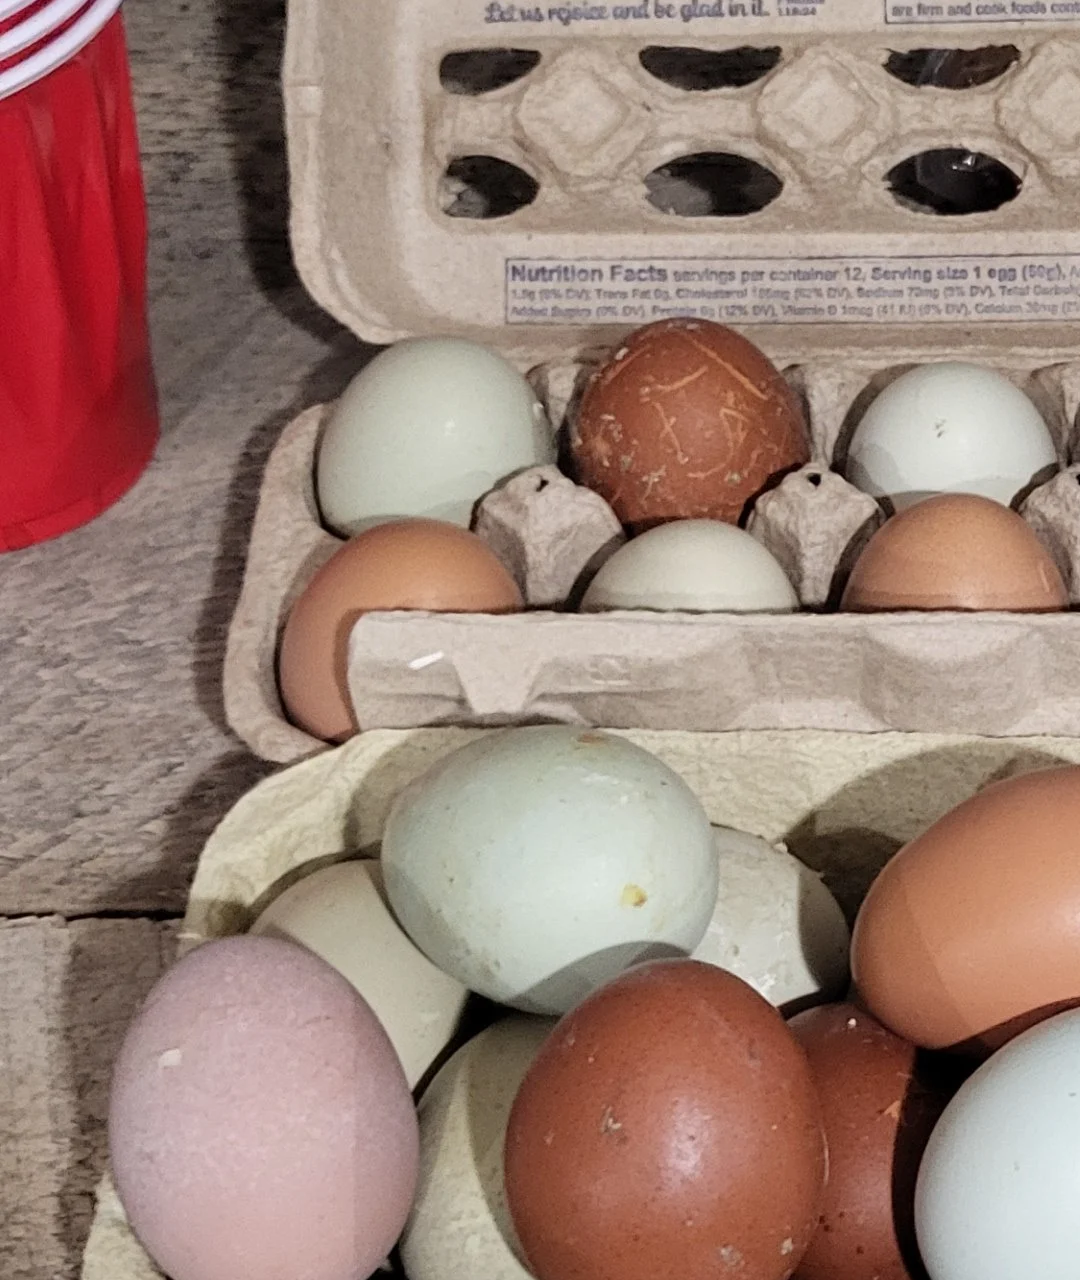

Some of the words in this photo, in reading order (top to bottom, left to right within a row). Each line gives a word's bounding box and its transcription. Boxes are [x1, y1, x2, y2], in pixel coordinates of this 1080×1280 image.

[519, 7, 545, 23] us
[547, 0, 608, 27] rejoice
[946, 2, 972, 17] and
[510, 264, 605, 283] Nutrition
[608, 264, 669, 283] Facts
[672, 268, 737, 286] servings
[740, 270, 766, 285] per
[768, 268, 839, 282] container
[870, 266, 933, 284] Serving
[936, 266, 969, 281] size
[972, 265, 982, 279] 1
[986, 267, 1018, 283] egg
